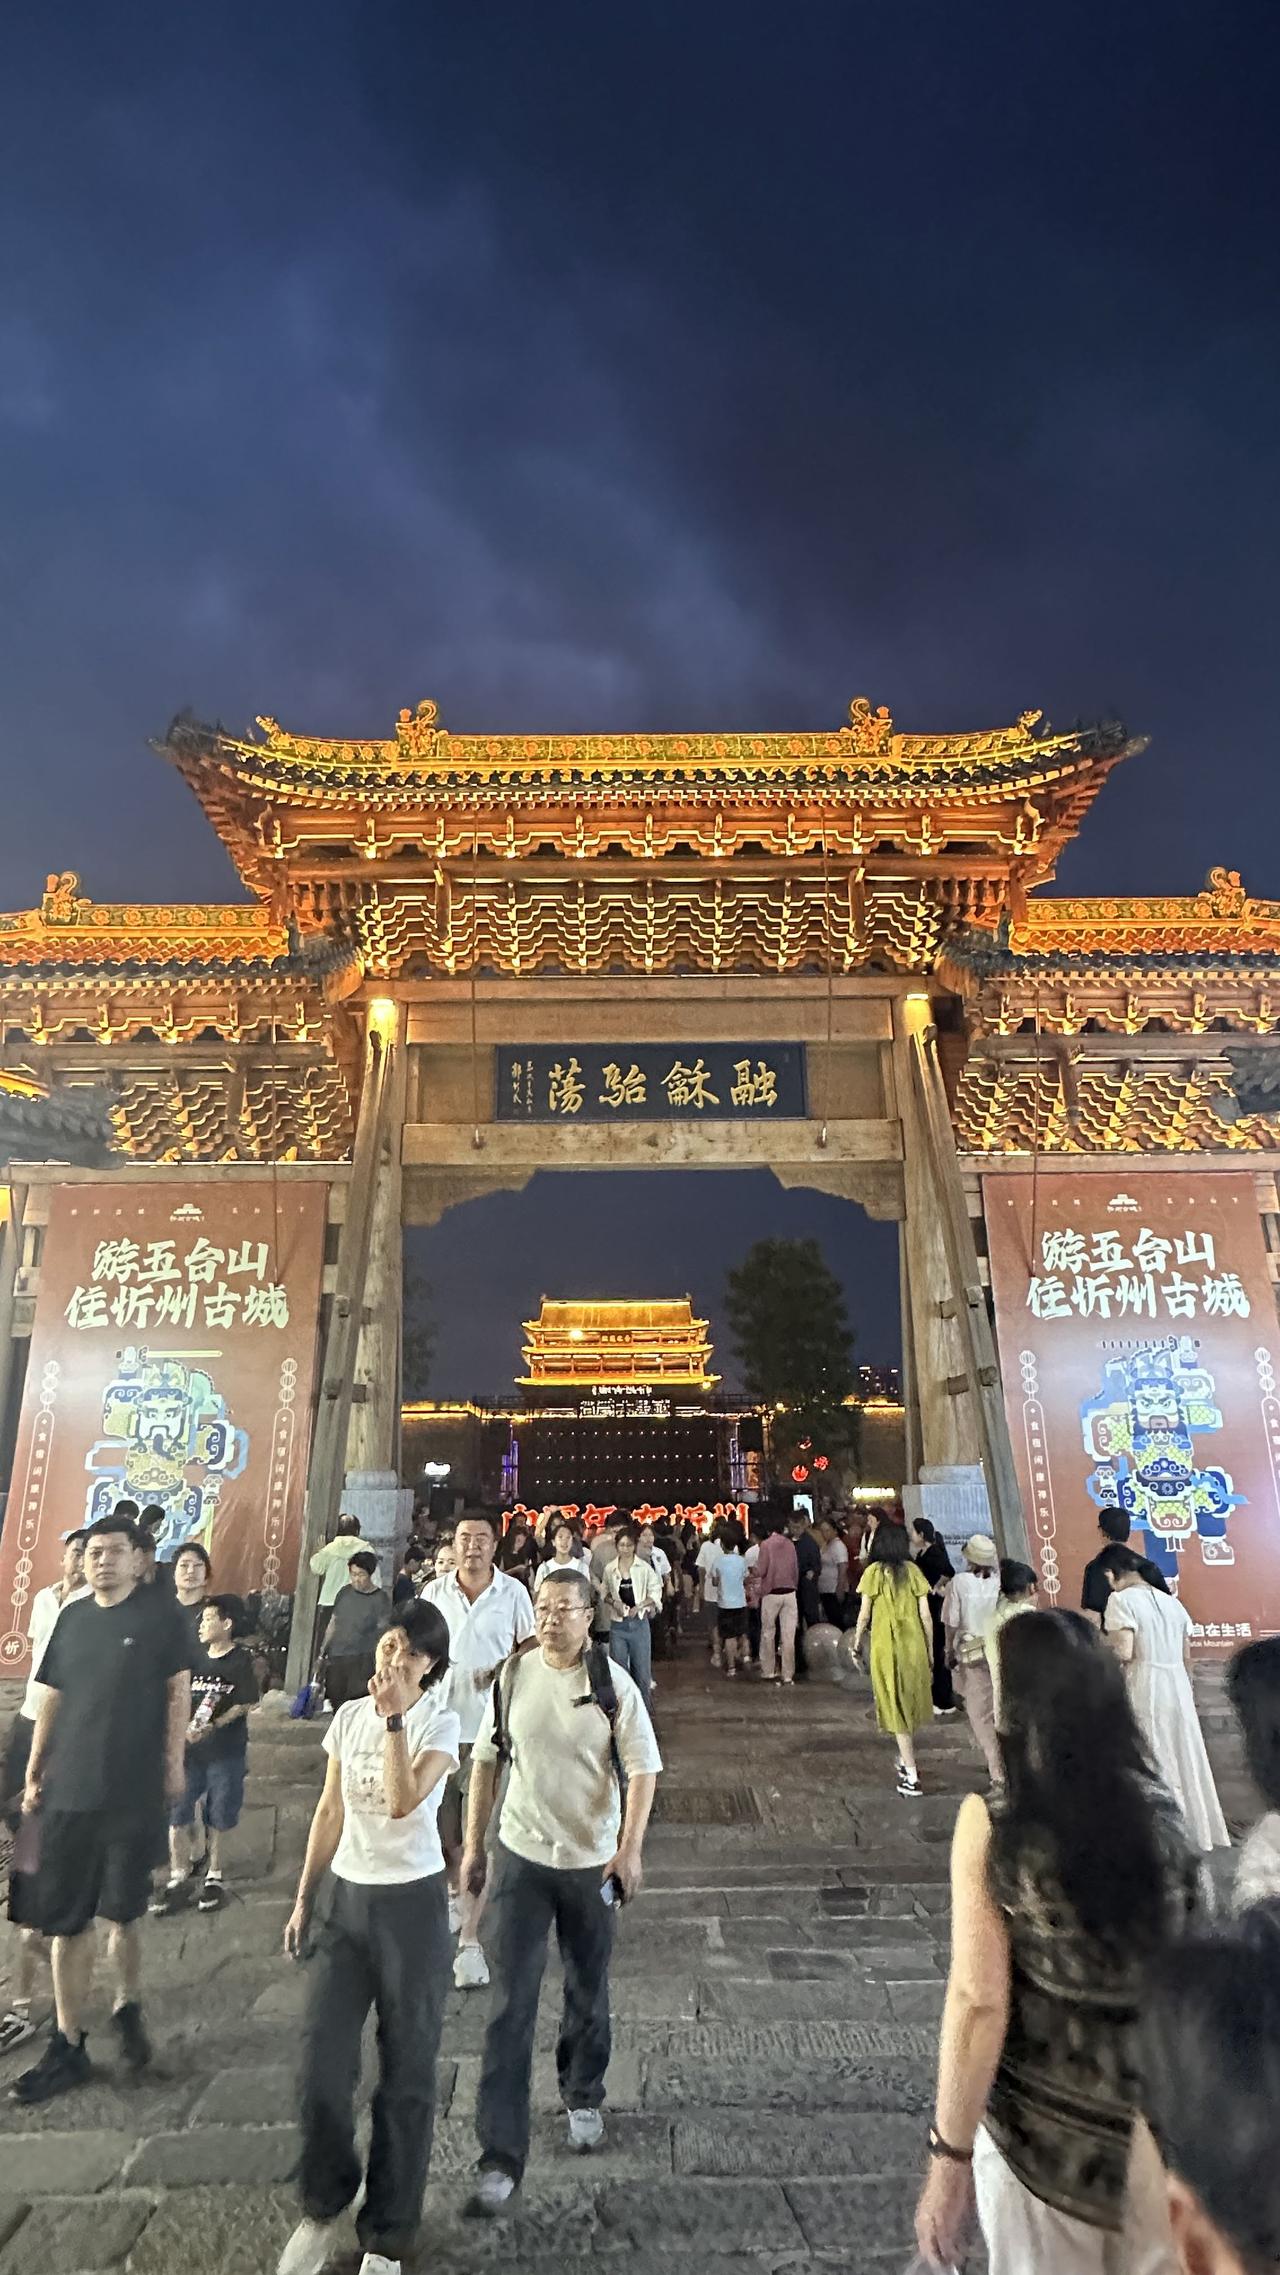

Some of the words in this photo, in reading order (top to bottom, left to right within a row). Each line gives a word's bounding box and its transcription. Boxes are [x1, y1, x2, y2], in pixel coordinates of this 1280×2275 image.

[91, 1237, 270, 1284] 游五台山
[1040, 1227, 1216, 1274] 游五台山
[64, 1282, 289, 1330] 住忻州古城
[1026, 1272, 1251, 1319] 住忻州古城
[4, 1640, 20, 1656] 忻
